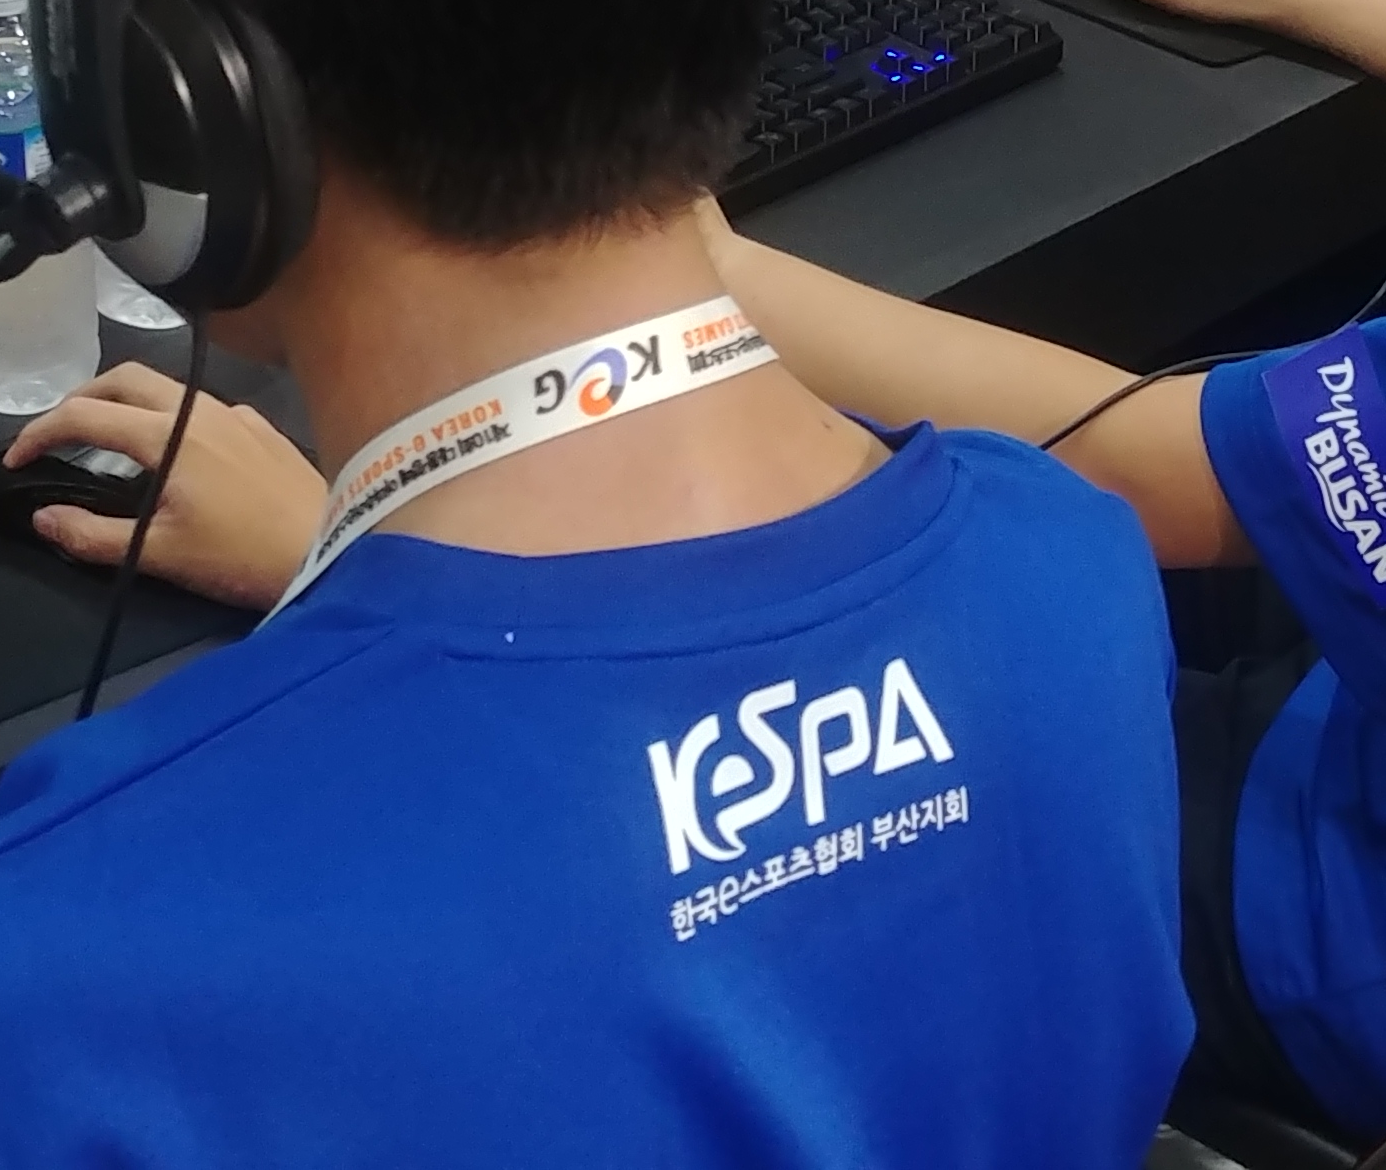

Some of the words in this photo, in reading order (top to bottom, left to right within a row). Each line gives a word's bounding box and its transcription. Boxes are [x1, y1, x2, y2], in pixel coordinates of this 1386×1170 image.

[432, 398, 503, 442] KOREA
[669, 822, 864, 942] 한국e스포츠협회
[870, 786, 970, 851] 부산지회
